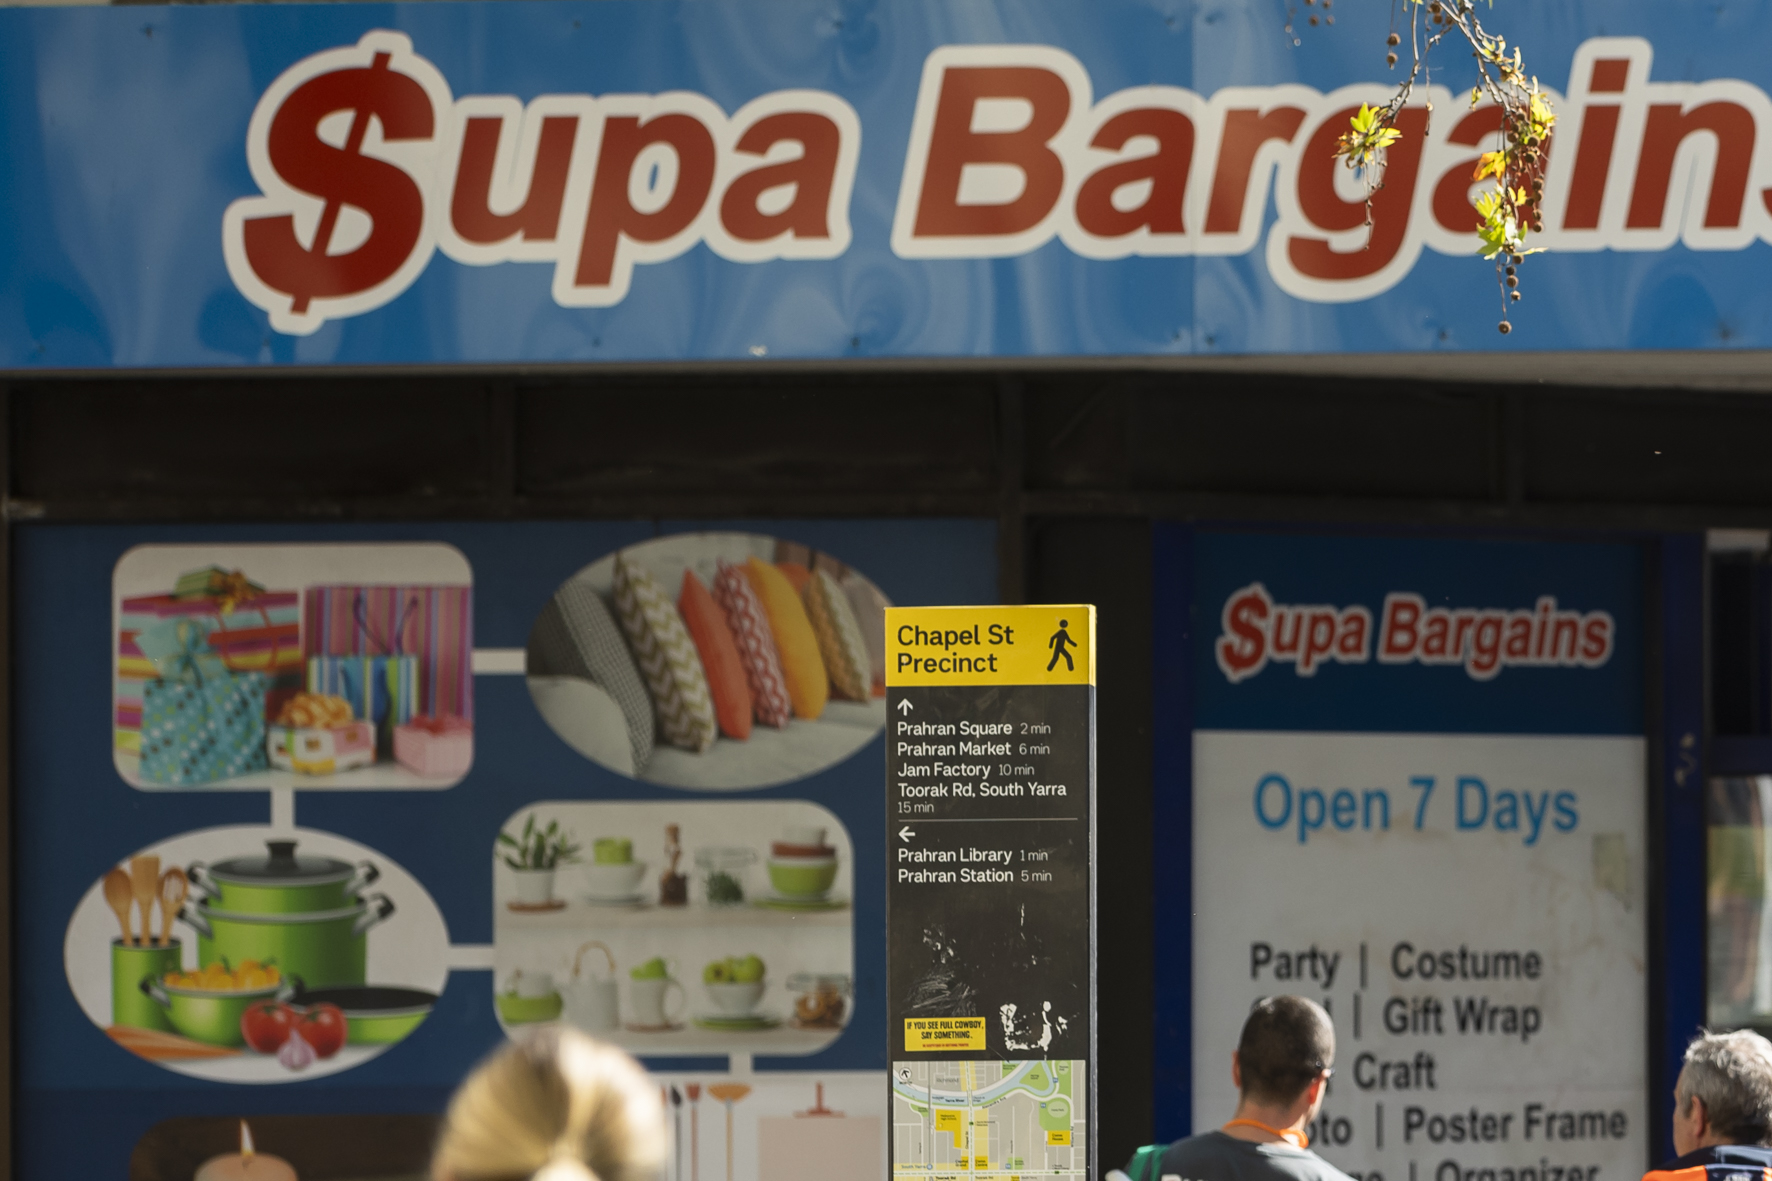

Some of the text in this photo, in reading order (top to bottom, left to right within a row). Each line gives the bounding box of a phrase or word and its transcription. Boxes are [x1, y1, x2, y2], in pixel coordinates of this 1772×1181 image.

[897, 624, 1014, 651] Chapel St
[1380, 596, 1611, 677] Bargains
[897, 652, 998, 674] Precinct
[897, 721, 1051, 739] Prahran Square 2 min
[897, 741, 1051, 757] Prahran Market 6 min
[898, 762, 1035, 780] Jam Factory 10 min
[898, 782, 1067, 798] Toorak Rd, South Yarra
[897, 801, 935, 814] 15 min
[1254, 772, 1580, 847] Open 7 Days
[898, 848, 1048, 866] Prahran Library 1 min
[898, 867, 1053, 884] Prahran Station 5 min
[1250, 940, 1544, 990] Party Costume
[907, 1020, 984, 1030] IF YOU SEE FULL COWBOY,
[1382, 996, 1445, 1036] Gift
[1453, 996, 1542, 1044] Wrap
[921, 1030, 973, 1040] SAY SOMETHING.
[1353, 1050, 1438, 1091] Craft
[1403, 1105, 1514, 1144] Poster
[1523, 1102, 1629, 1141] Frame
